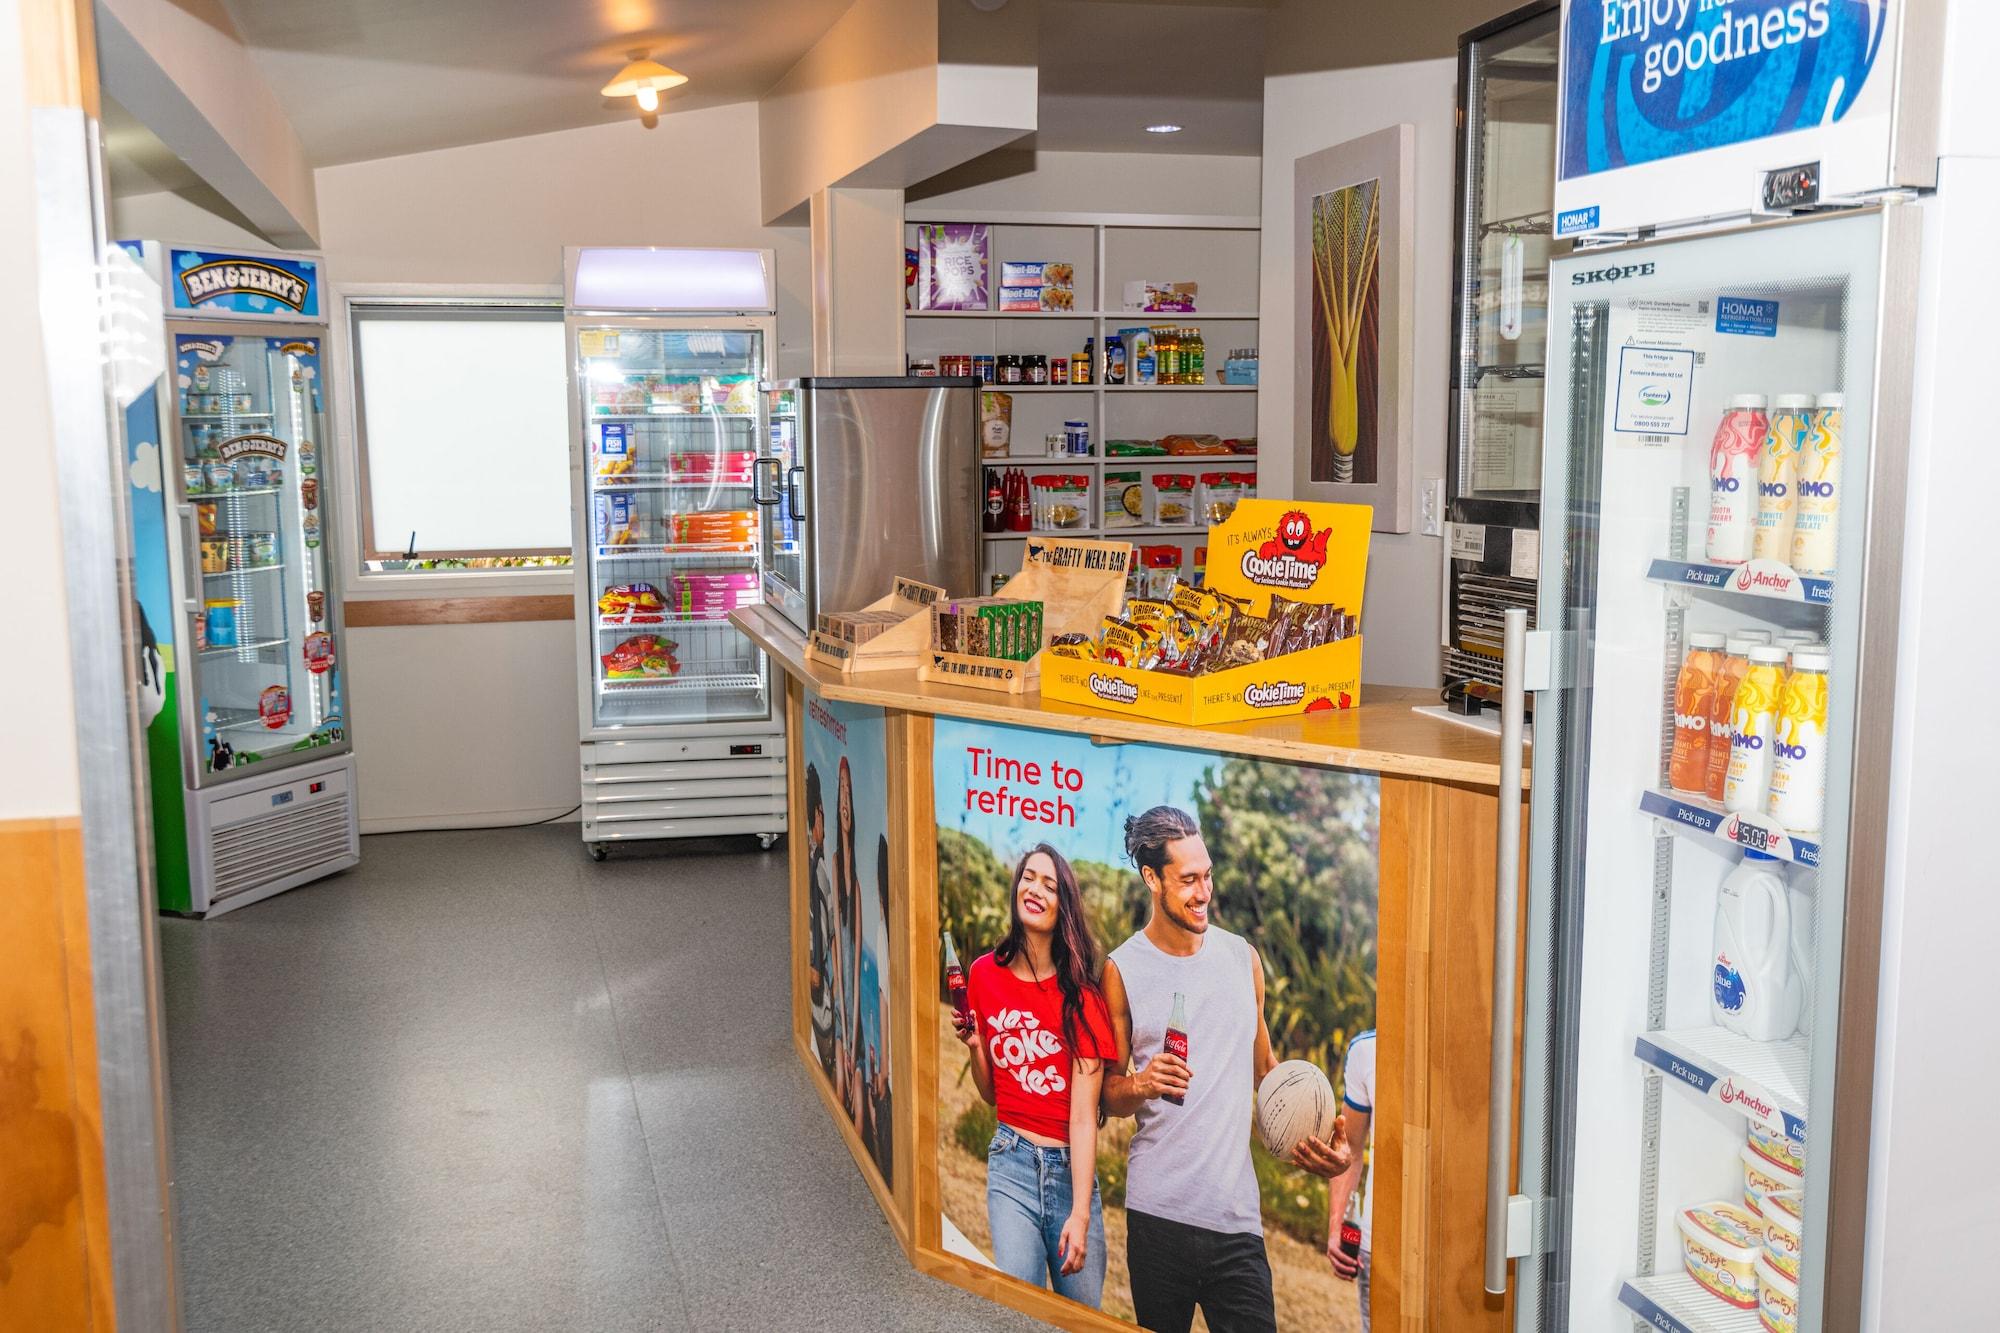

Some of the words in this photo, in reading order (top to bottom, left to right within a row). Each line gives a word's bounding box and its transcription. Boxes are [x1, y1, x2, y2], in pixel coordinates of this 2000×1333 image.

[1600, 0, 1689, 44] Enjoy
[1642, 0, 1830, 93] goodness
[1561, 212, 1589, 228] HONAR
[944, 256, 972, 266] RICE
[944, 266, 974, 276] POPS
[1571, 262, 1655, 285] SKOPE
[1722, 302, 1763, 316] HONAR
[1654, 353, 1668, 361] fridge
[1643, 391, 1668, 399] Fonterra
[1227, 533, 1240, 546] IT'S
[1243, 528, 1272, 543] ALWAYS
[1053, 547, 1083, 567] CRAFTY
[1085, 549, 1106, 569] WEKA
[1109, 551, 1126, 571] BAR
[1276, 578, 1289, 587] Cookie
[1686, 569, 1704, 581] Pick
[1704, 573, 1714, 584] up
[1752, 571, 1791, 589] Anchor
[1107, 627, 1134, 644] ORIGINAL
[1307, 685, 1320, 693] LIKE
[1204, 692, 1230, 705] THERE'S
[1232, 693, 1242, 703] NO
[967, 747, 1041, 785] Time
[1051, 760, 1083, 792] to
[967, 787, 1075, 827] refresh
[1678, 808, 1694, 822] Pick
[1694, 814, 1705, 827] up
[1739, 824, 1767, 848] $5.00
[1716, 974, 1732, 989] blue
[1008, 1064, 1066, 1096] Yes
[1671, 1061, 1687, 1077] Pick
[1688, 1070, 1698, 1084] up
[1735, 1090, 1772, 1117] Anchor
[1767, 1226, 1794, 1252] Country
[1708, 1252, 1727, 1268] Soft
[1764, 1288, 1793, 1316] Country
[1655, 1313, 1671, 1332] Pick
